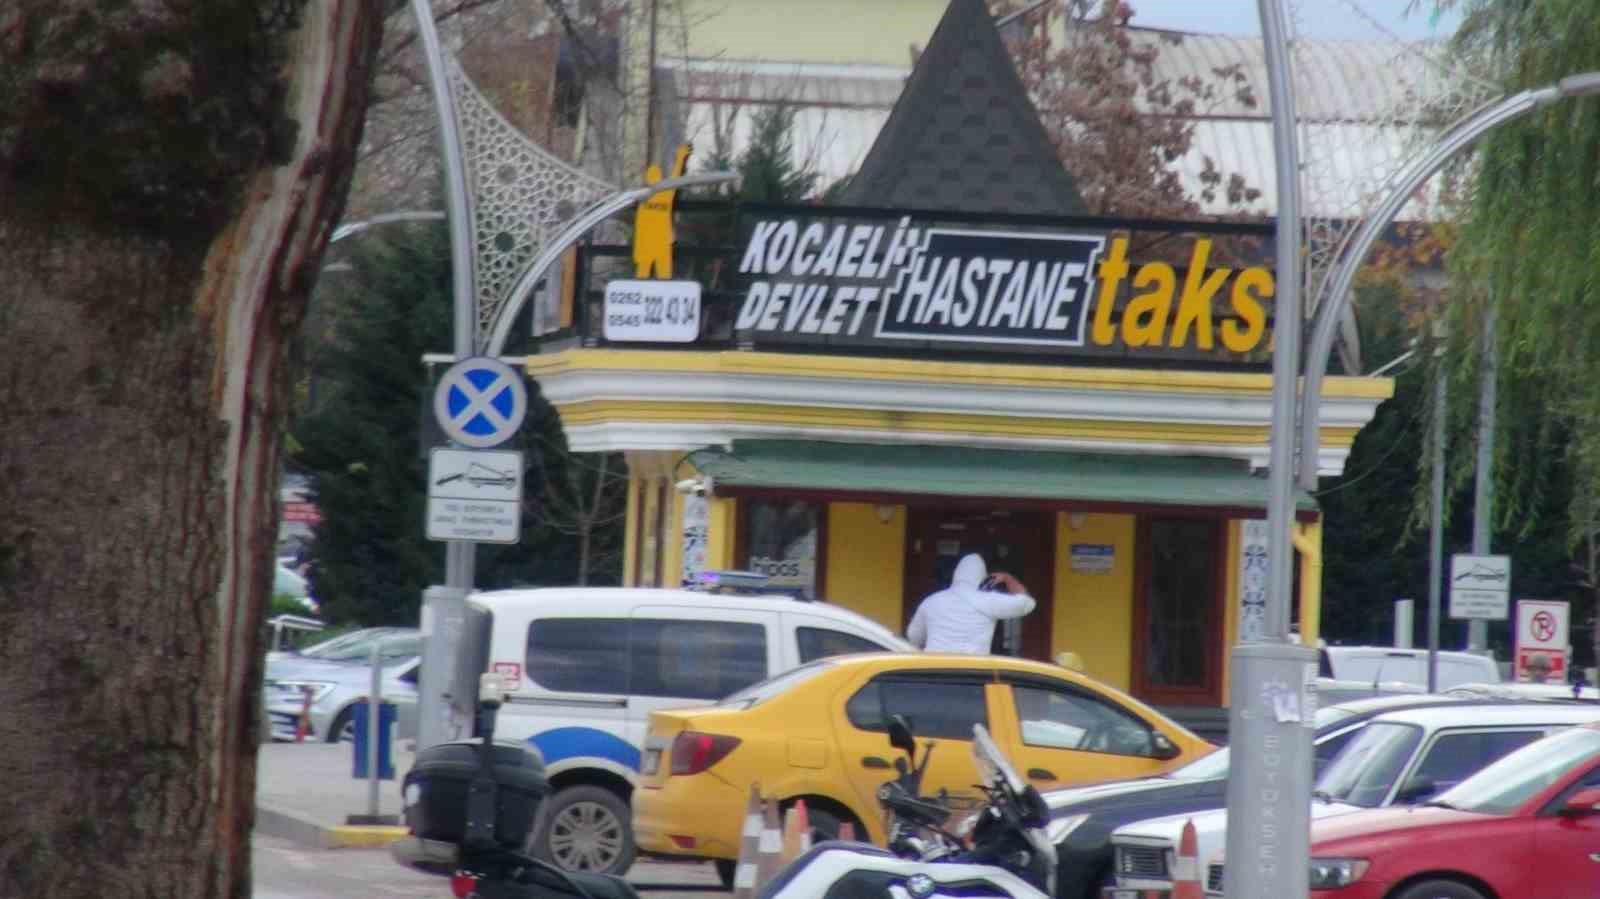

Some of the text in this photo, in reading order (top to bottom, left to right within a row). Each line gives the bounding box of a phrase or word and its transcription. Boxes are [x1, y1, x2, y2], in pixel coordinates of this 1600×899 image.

[738, 215, 911, 279] KOCAELİ
[734, 281, 881, 336] DEVLET
[896, 236, 1276, 352] HASTANE taks
